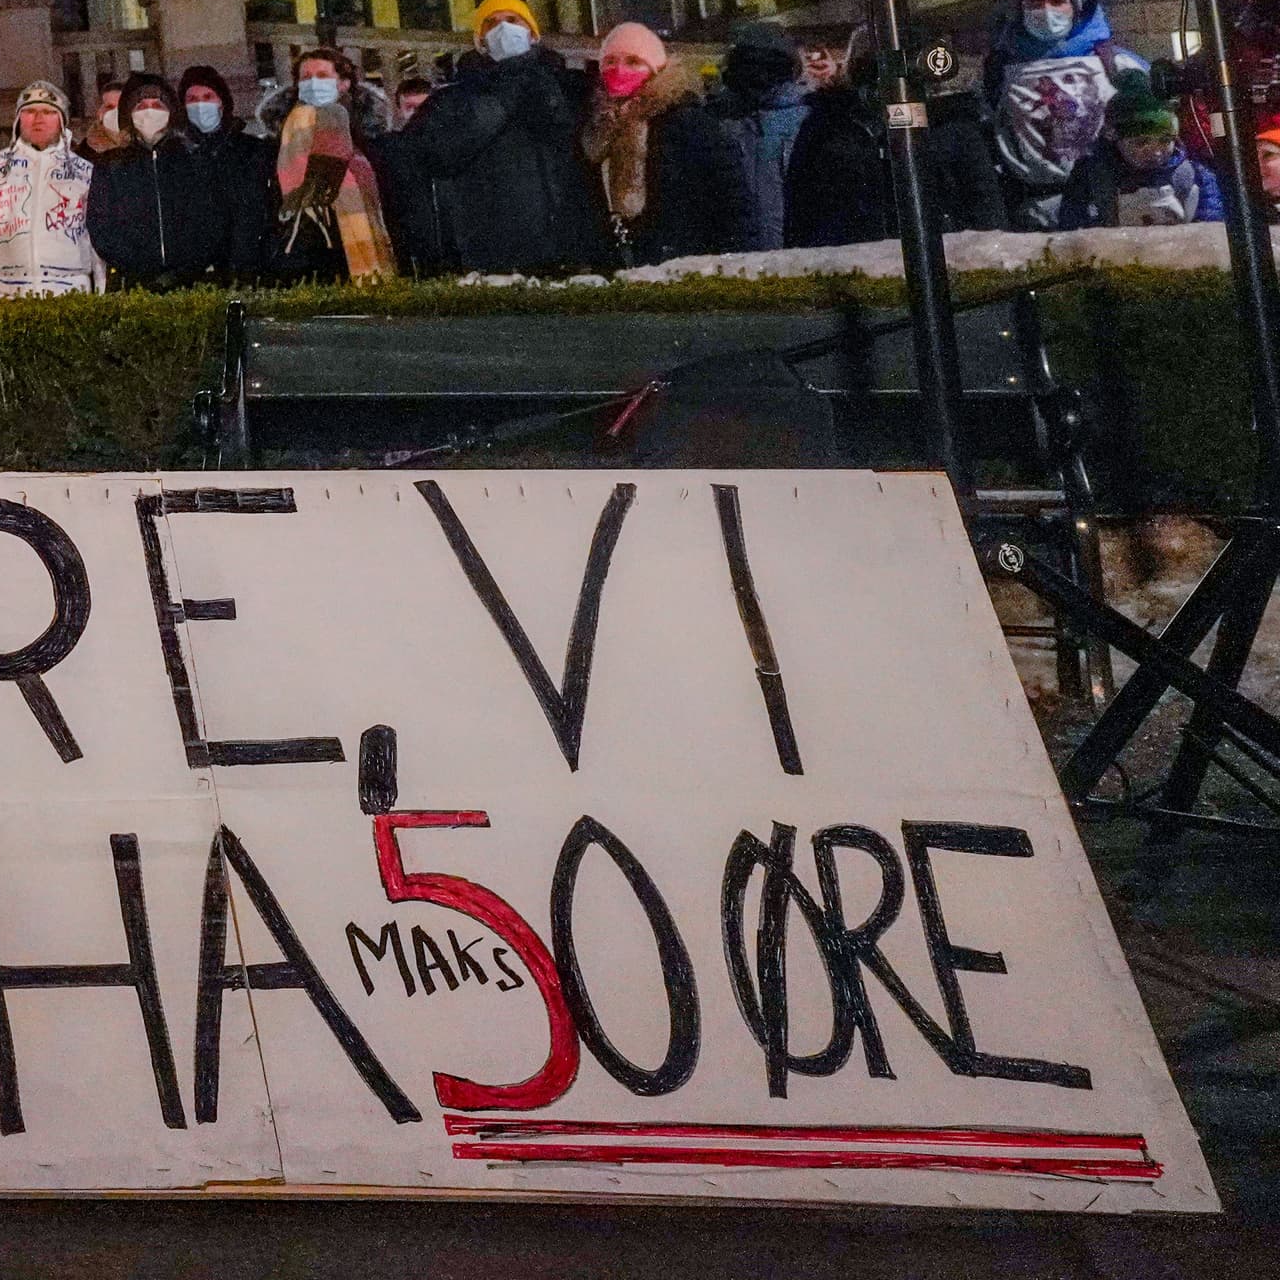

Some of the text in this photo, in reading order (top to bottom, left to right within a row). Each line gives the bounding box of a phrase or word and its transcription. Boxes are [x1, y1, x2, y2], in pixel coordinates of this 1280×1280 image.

[412, 480, 805, 776] VI
[345, 920, 526, 1000] MAKS
[371, 809, 701, 1111] 50
[720, 819, 1094, 1100] ØRE
